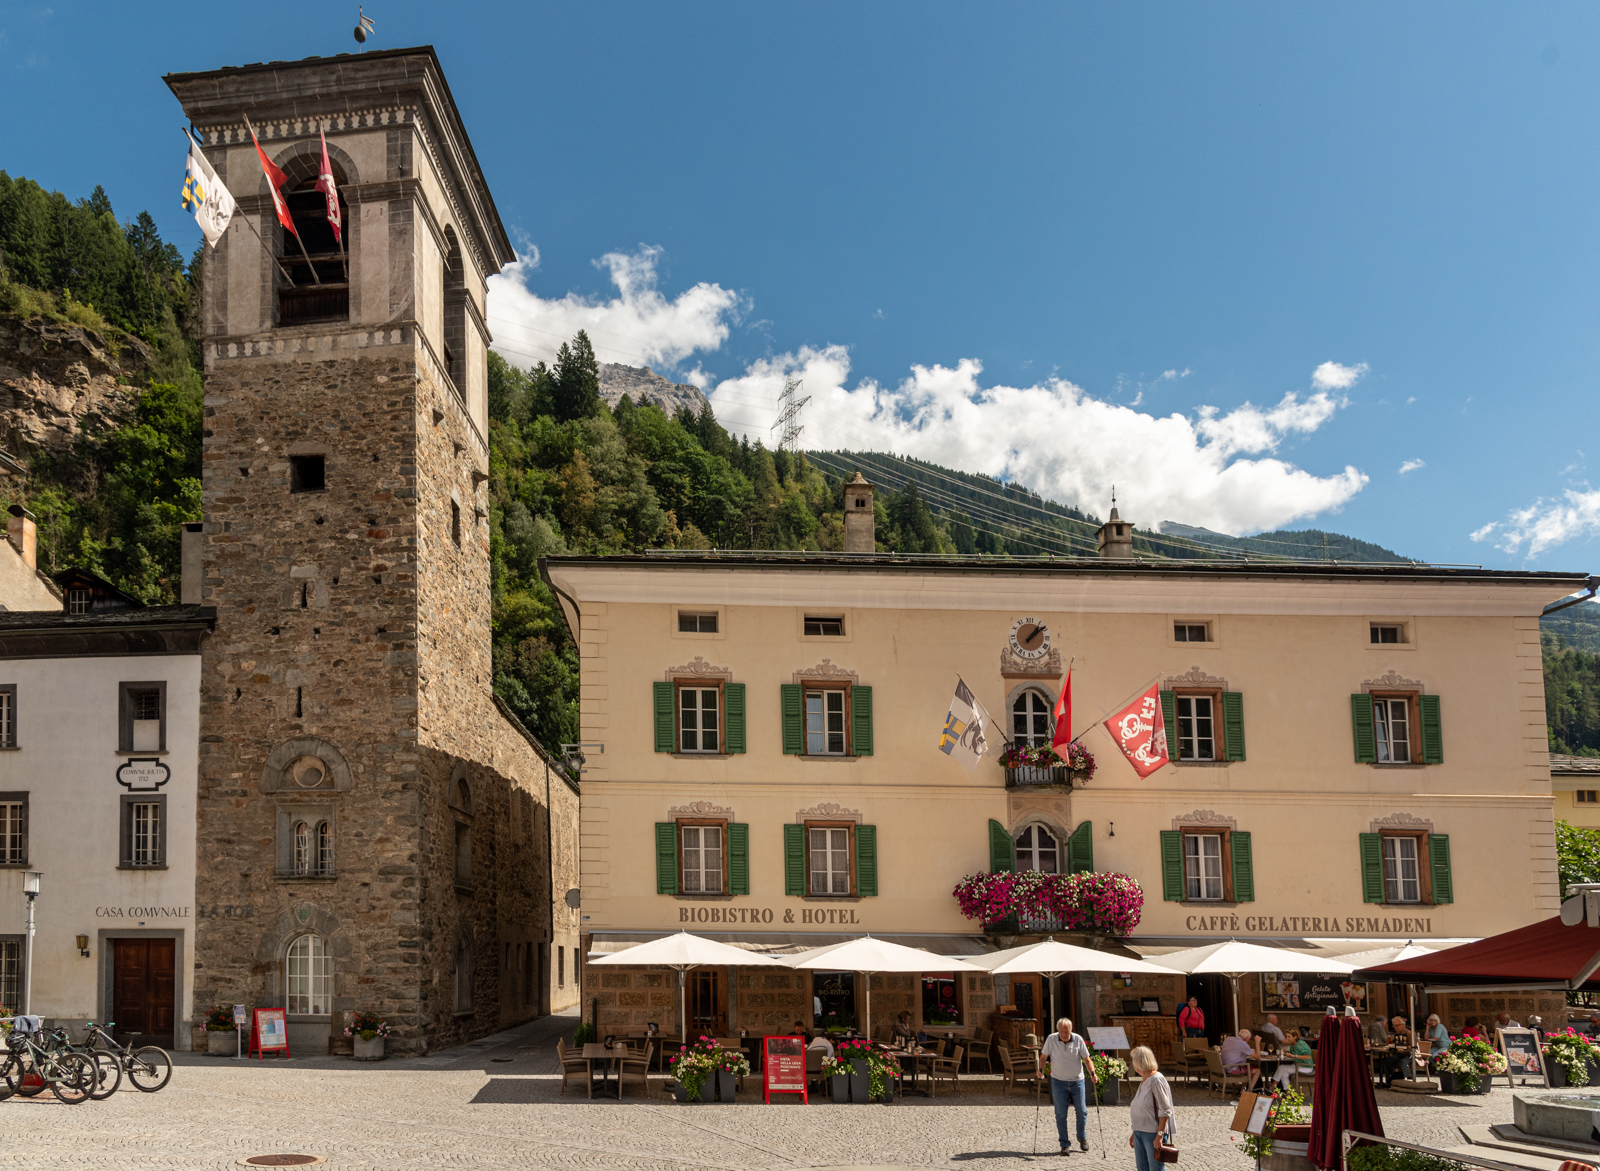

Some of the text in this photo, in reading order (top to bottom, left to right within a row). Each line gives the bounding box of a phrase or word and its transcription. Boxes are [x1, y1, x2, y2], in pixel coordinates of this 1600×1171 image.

[95, 906, 190, 918] CASA COMVNALE
[200, 905, 254, 918] LA TOR
[678, 907, 860, 924] BIOBISTRO & HOTEL
[1185, 912, 1433, 933] CAFFÈ GELATERIA SEMADENI
[1304, 992, 1338, 1001] Artigianale
